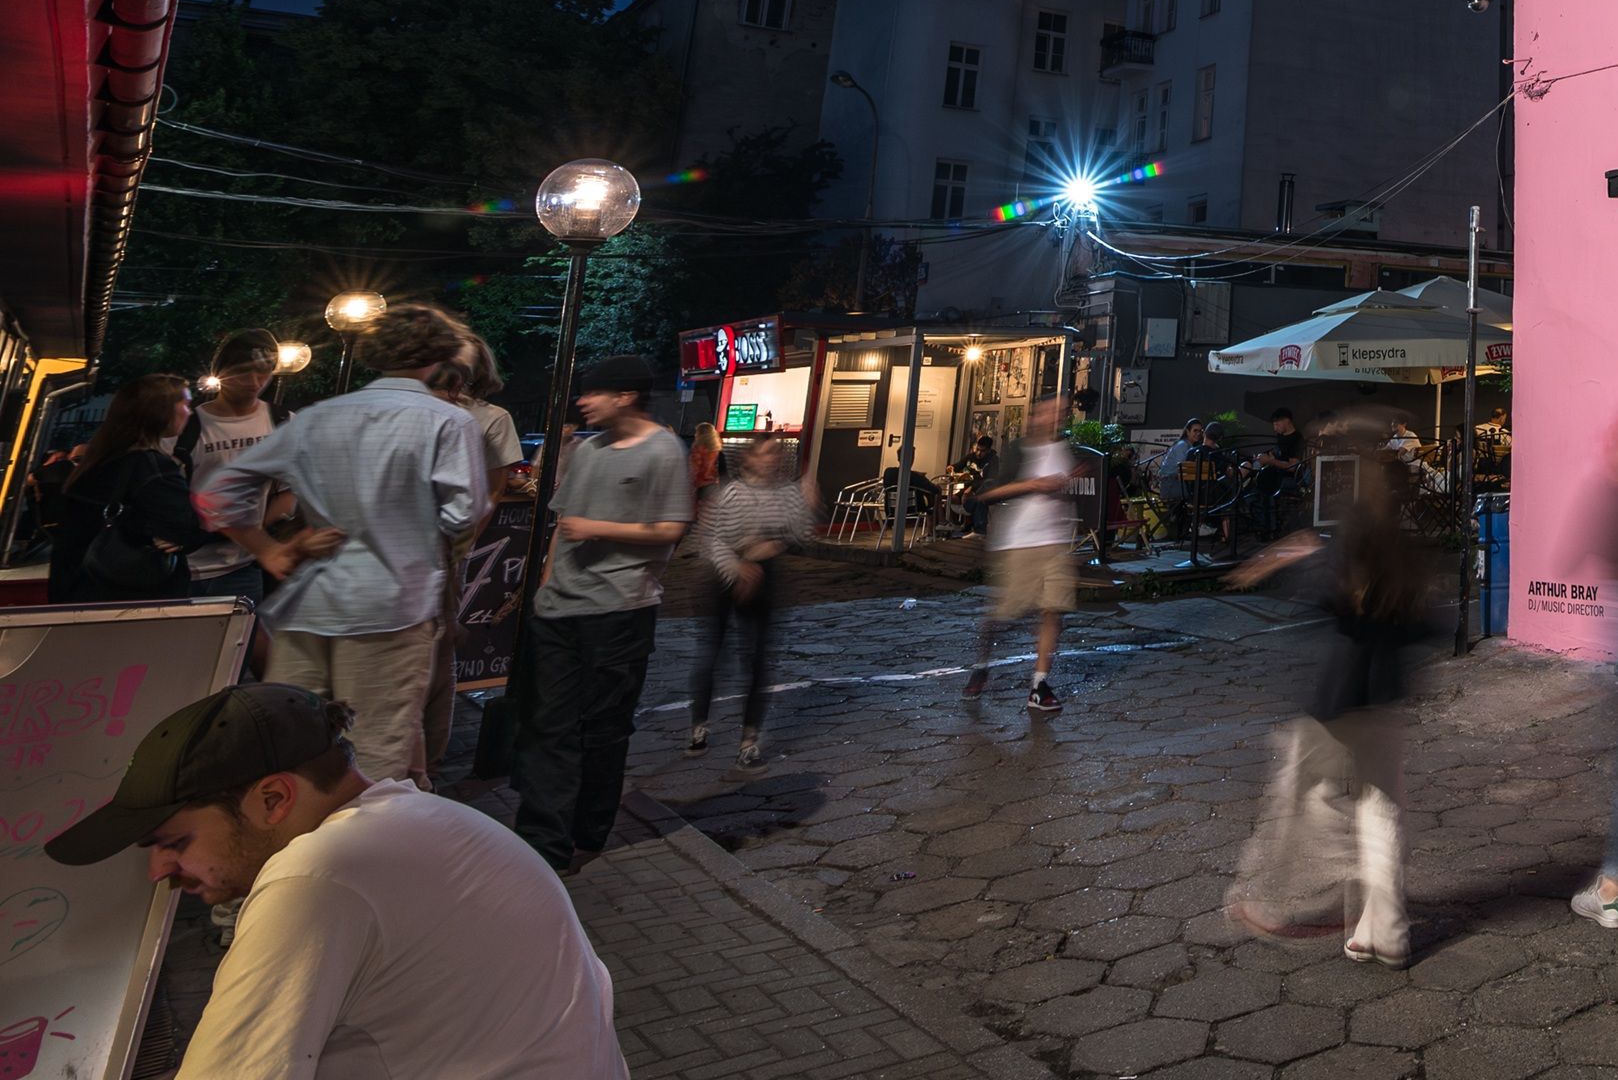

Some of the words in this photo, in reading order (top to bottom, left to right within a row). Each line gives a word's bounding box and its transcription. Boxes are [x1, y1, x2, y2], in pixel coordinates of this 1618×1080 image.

[735, 331, 768, 363] BOSS
[1352, 347, 1406, 361] klepsydra
[1491, 344, 1512, 357] ŻYW
[205, 436, 262, 453] HILFIG
[456, 536, 511, 623] 7
[1528, 581, 1567, 599] ARTHUR
[1571, 585, 1598, 601] BRAY
[1567, 603, 1604, 617] DIRECTOR
